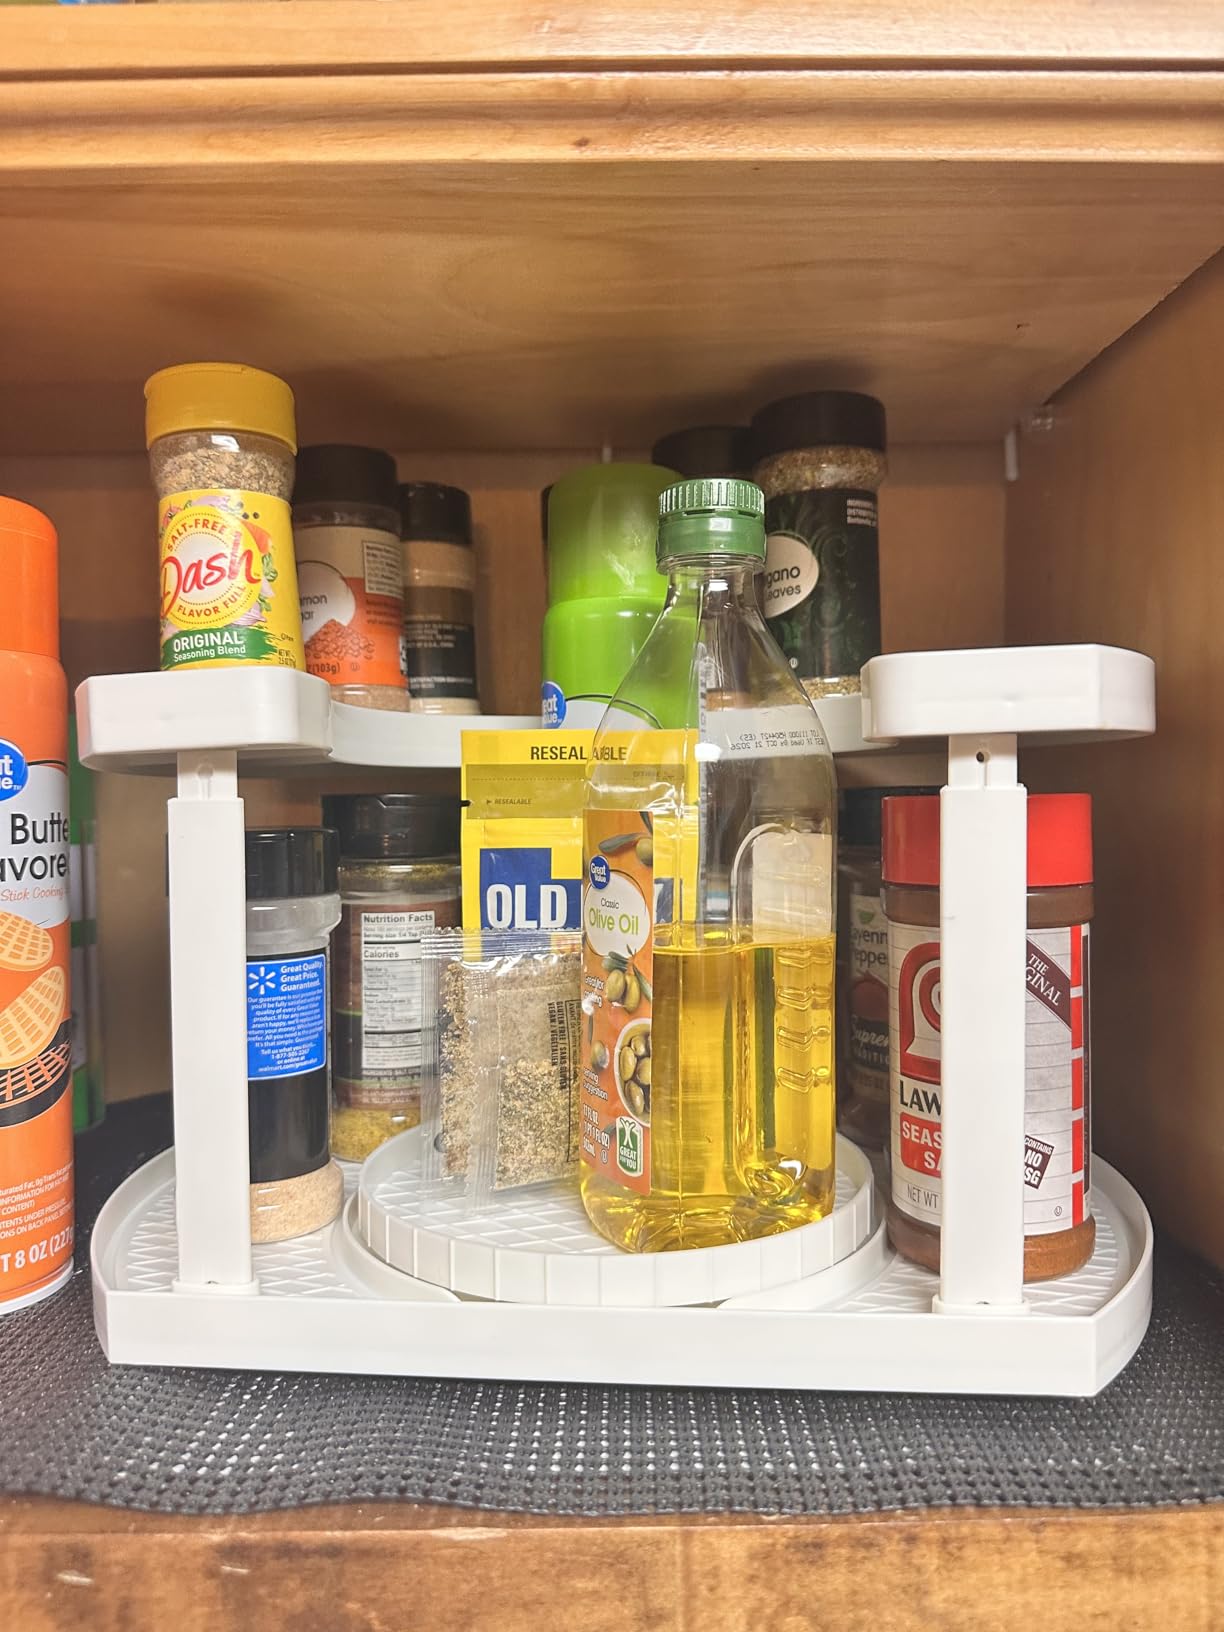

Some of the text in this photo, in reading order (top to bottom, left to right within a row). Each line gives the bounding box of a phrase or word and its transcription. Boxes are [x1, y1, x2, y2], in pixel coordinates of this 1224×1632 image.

[167, 518, 227, 552] SALT-FREE
[160, 530, 262, 619] Dash
[766, 565, 800, 588] gano
[177, 585, 247, 618] FLAVOR FULL
[767, 584, 801, 600] eaves
[173, 632, 244, 652] ORIGINAL
[174, 644, 246, 663] Seasoning Blend
[10, 812, 69, 845] Butte
[591, 862, 606, 876] Great
[486, 884, 568, 929] OLD
[600, 898, 620, 910] Classic
[364, 914, 433, 923] Nutrition Facts
[588, 907, 639, 936] Olive Oil
[280, 965, 302, 974] Great
[1028, 954, 1049, 976] THE
[280, 974, 302, 983] Great
[1026, 966, 1061, 1006] GINAL
[548, 1002, 556, 1023] VEGAN
[900, 1080, 941, 1116] LAW
[902, 1120, 942, 1150] SEAS
[1024, 1136, 1053, 1154] CONTAINS
[620, 1146, 637, 1160] GREAT
[1025, 1150, 1043, 1168] NO
[626, 1160, 637, 1170] YOU
[1024, 1165, 1041, 1185] SG
[907, 1184, 938, 1208] NET WT
[24, 1208, 45, 1221] UNDER
[0, 1228, 15, 1240] ONS
[16, 1225, 27, 1235] ON
[0, 1253, 11, 1272] T
[15, 1250, 25, 1268] 8
[29, 1240, 47, 1264] OZ
